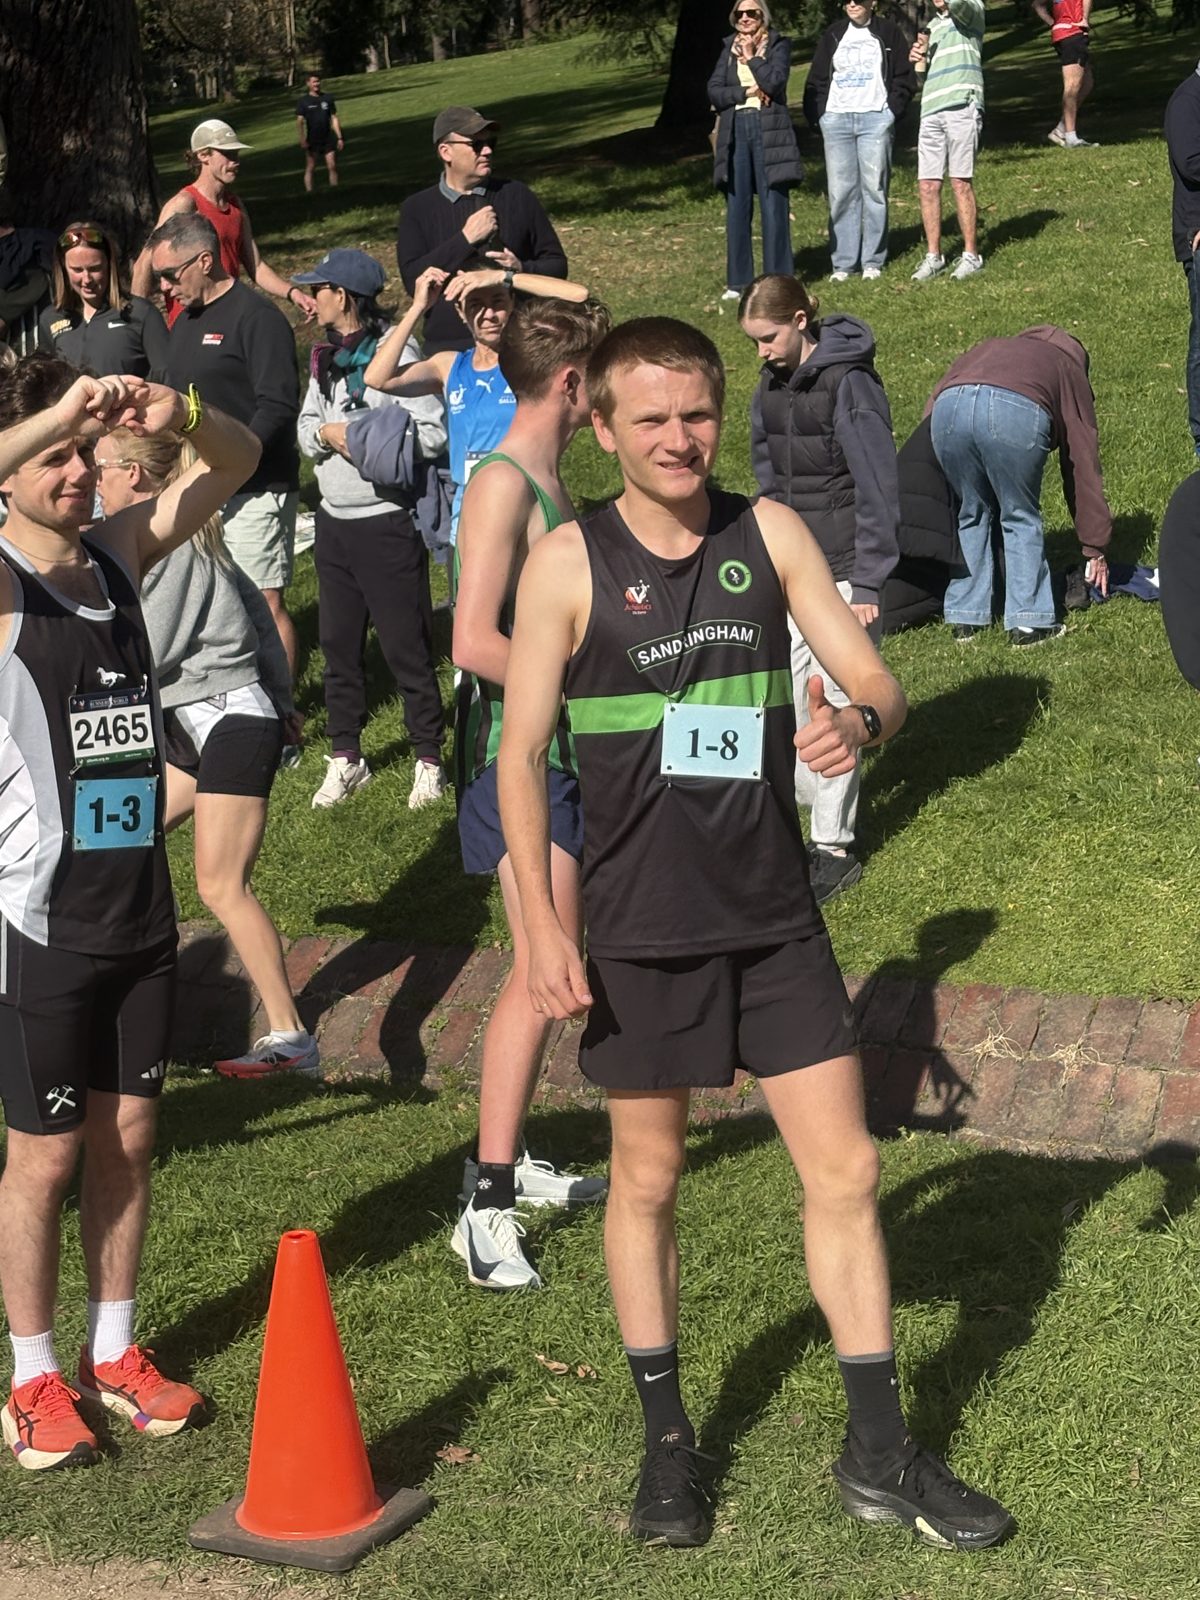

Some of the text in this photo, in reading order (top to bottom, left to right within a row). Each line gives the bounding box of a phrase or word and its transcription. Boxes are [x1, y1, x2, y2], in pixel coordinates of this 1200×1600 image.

[74, 712, 149, 751] 2465
[686, 727, 739, 761] 1-8
[89, 795, 141, 834] 1-3
